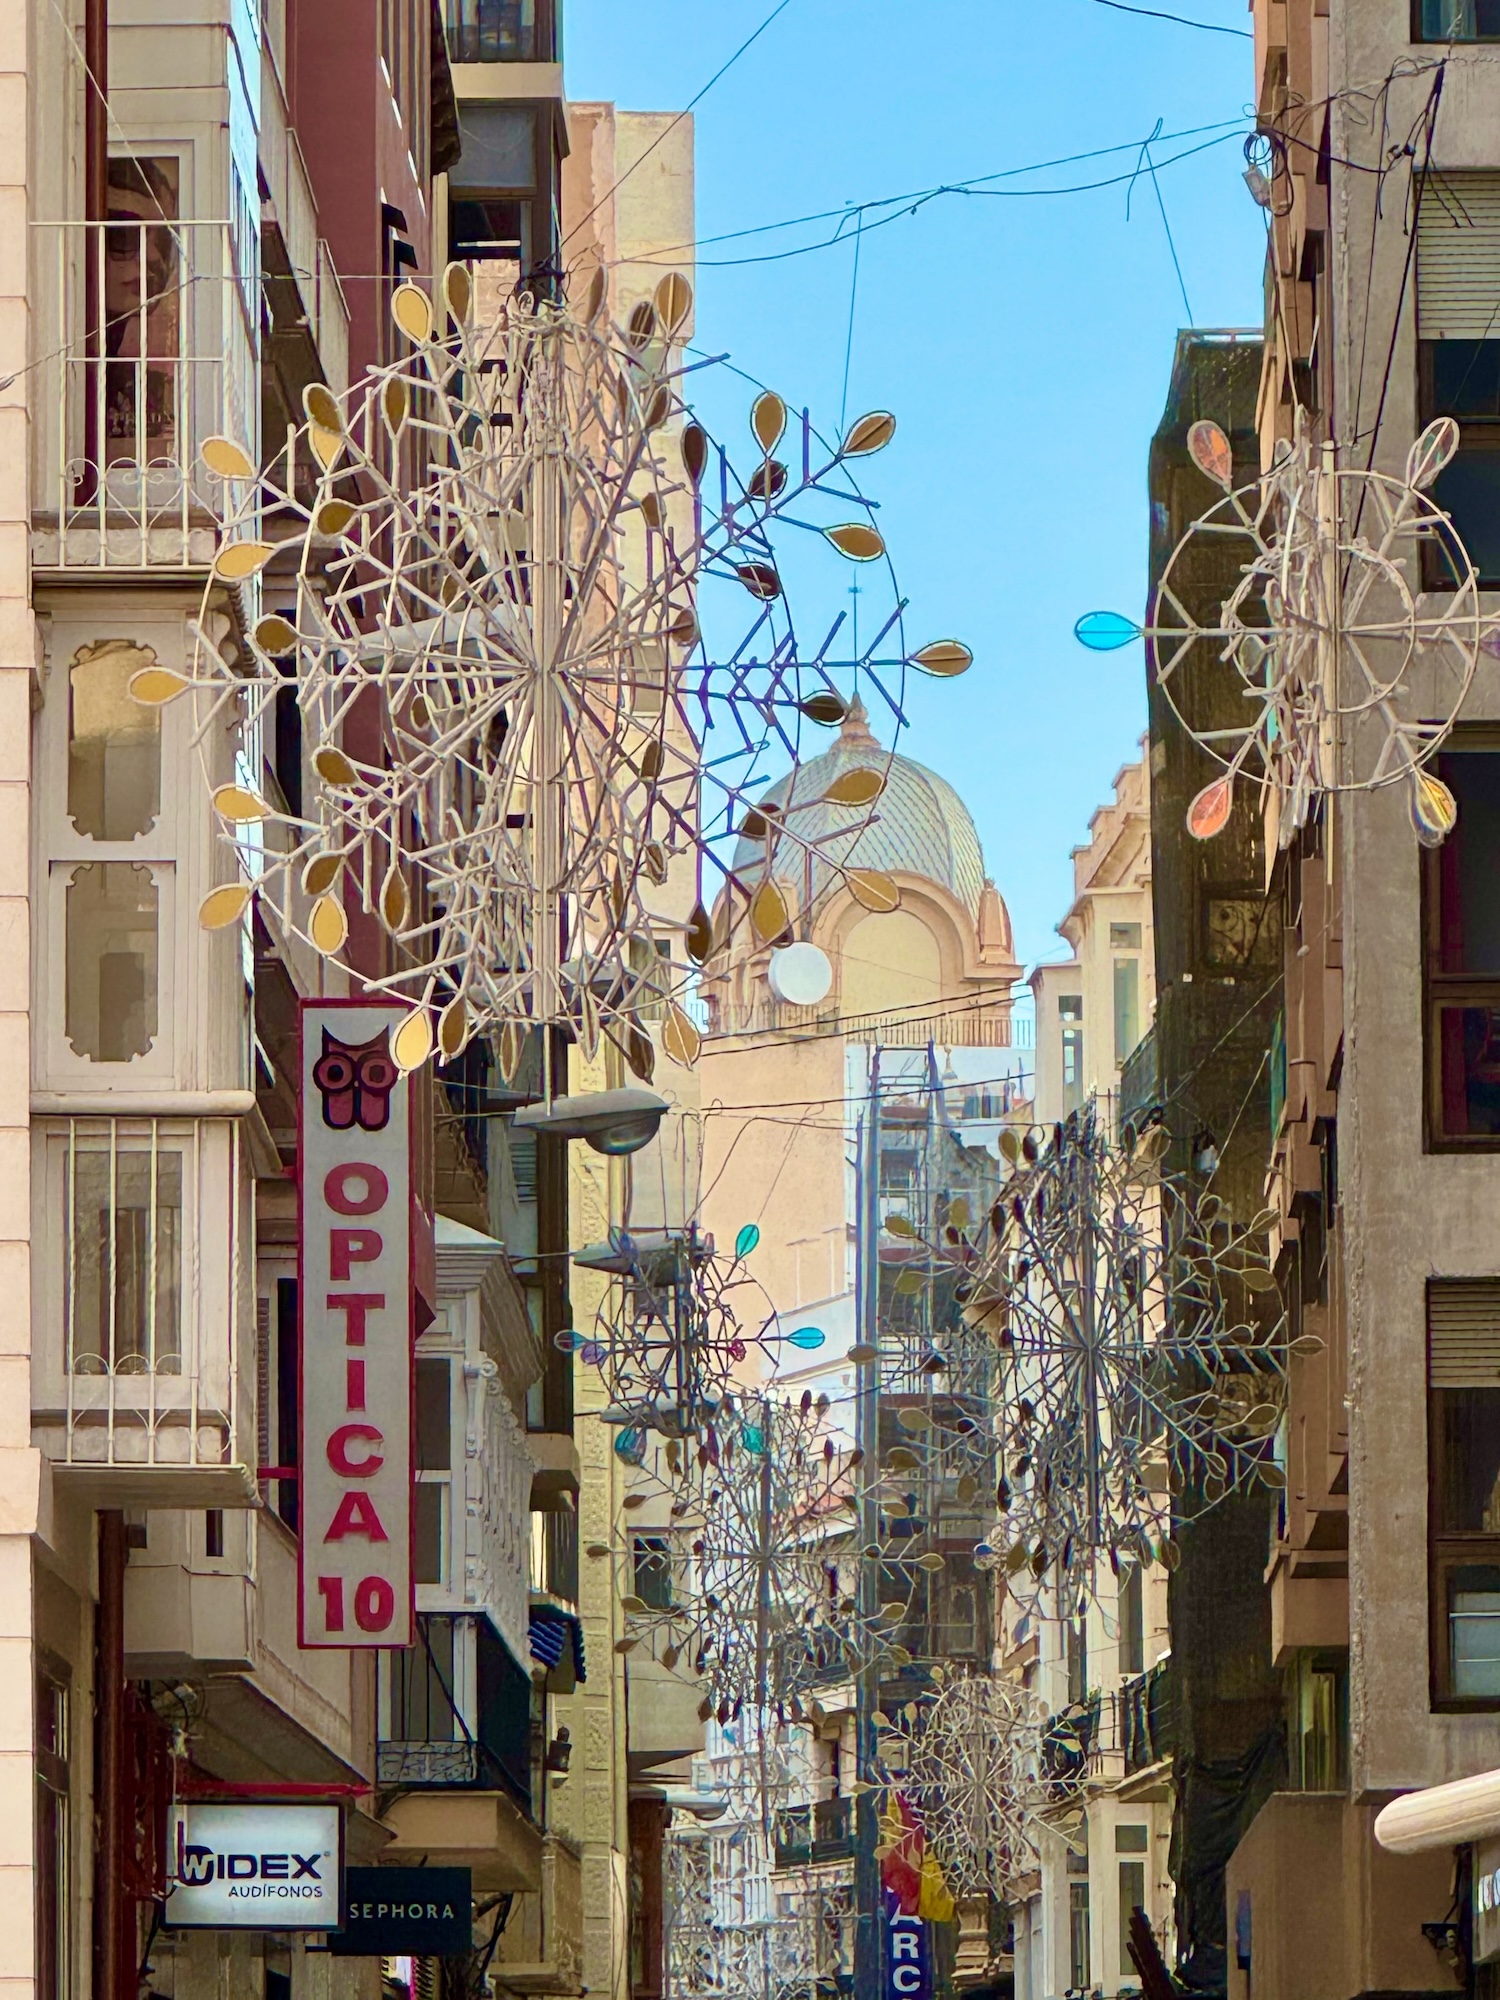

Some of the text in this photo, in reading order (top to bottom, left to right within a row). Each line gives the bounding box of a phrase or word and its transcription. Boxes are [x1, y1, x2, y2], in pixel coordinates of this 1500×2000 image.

[318, 1162, 395, 1633] OPTICA 10
[228, 1884, 323, 1898] AUDÍFONOS
[350, 1903, 454, 1919] SEPHORA
[886, 1886, 923, 2000] ARC
